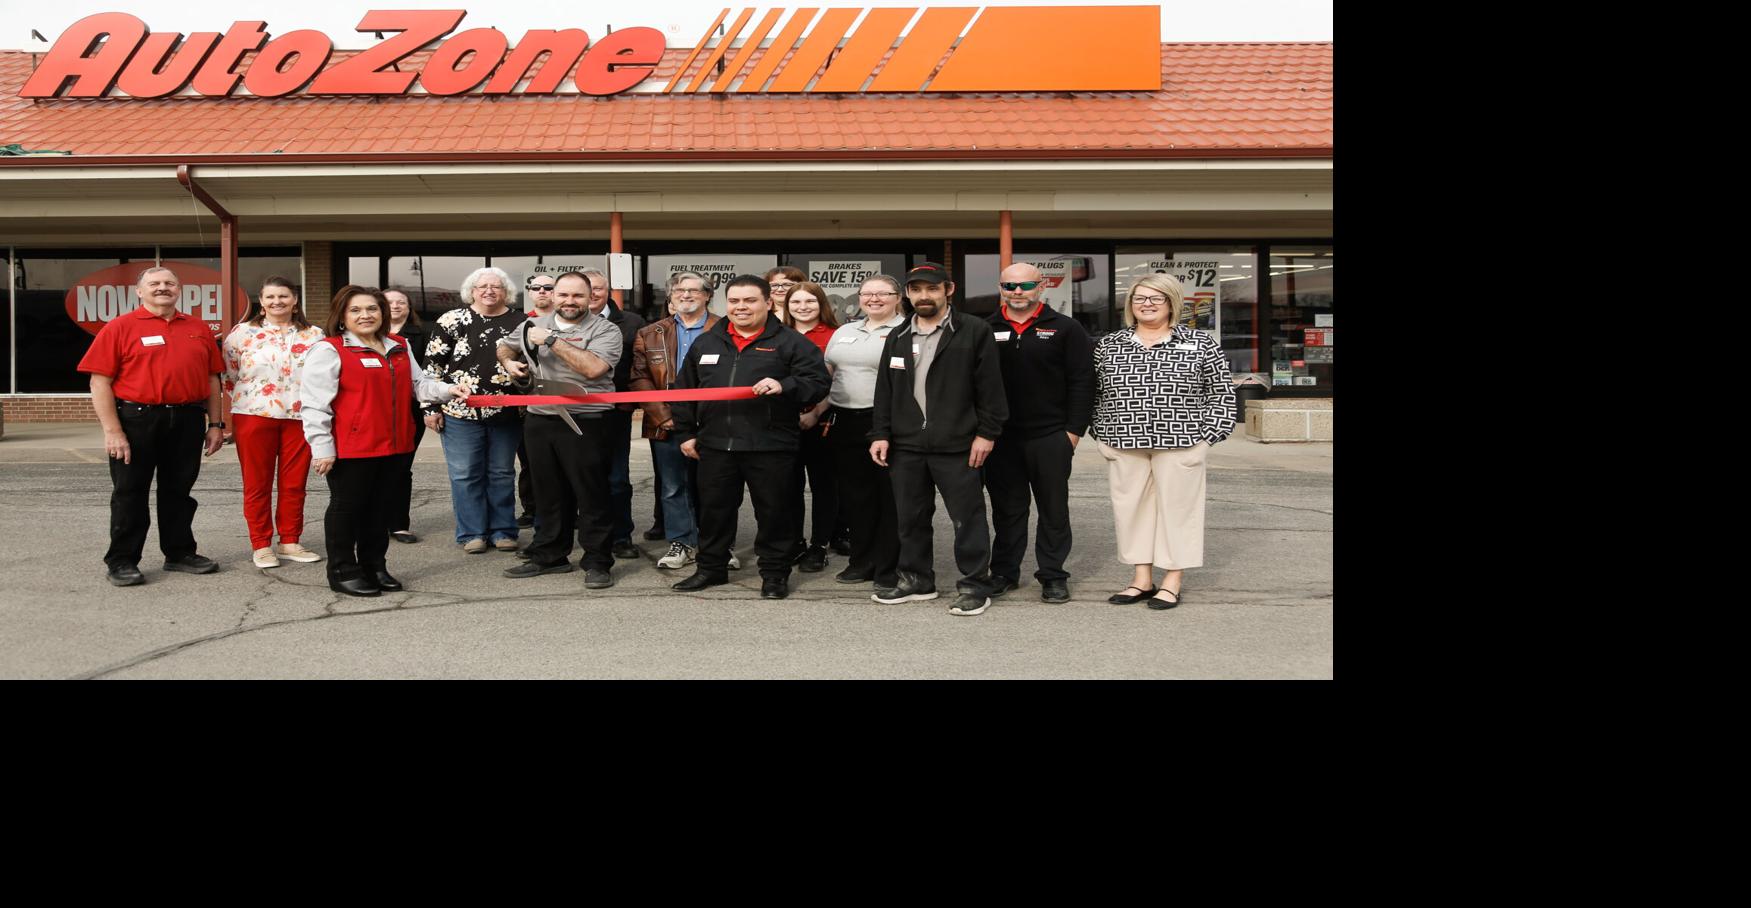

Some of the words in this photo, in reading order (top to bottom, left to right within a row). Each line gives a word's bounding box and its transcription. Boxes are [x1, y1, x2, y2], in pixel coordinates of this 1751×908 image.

[18, 10, 667, 98] AutoZone
[811, 271, 847, 283] SAVE
[1187, 269, 1216, 287] $12
